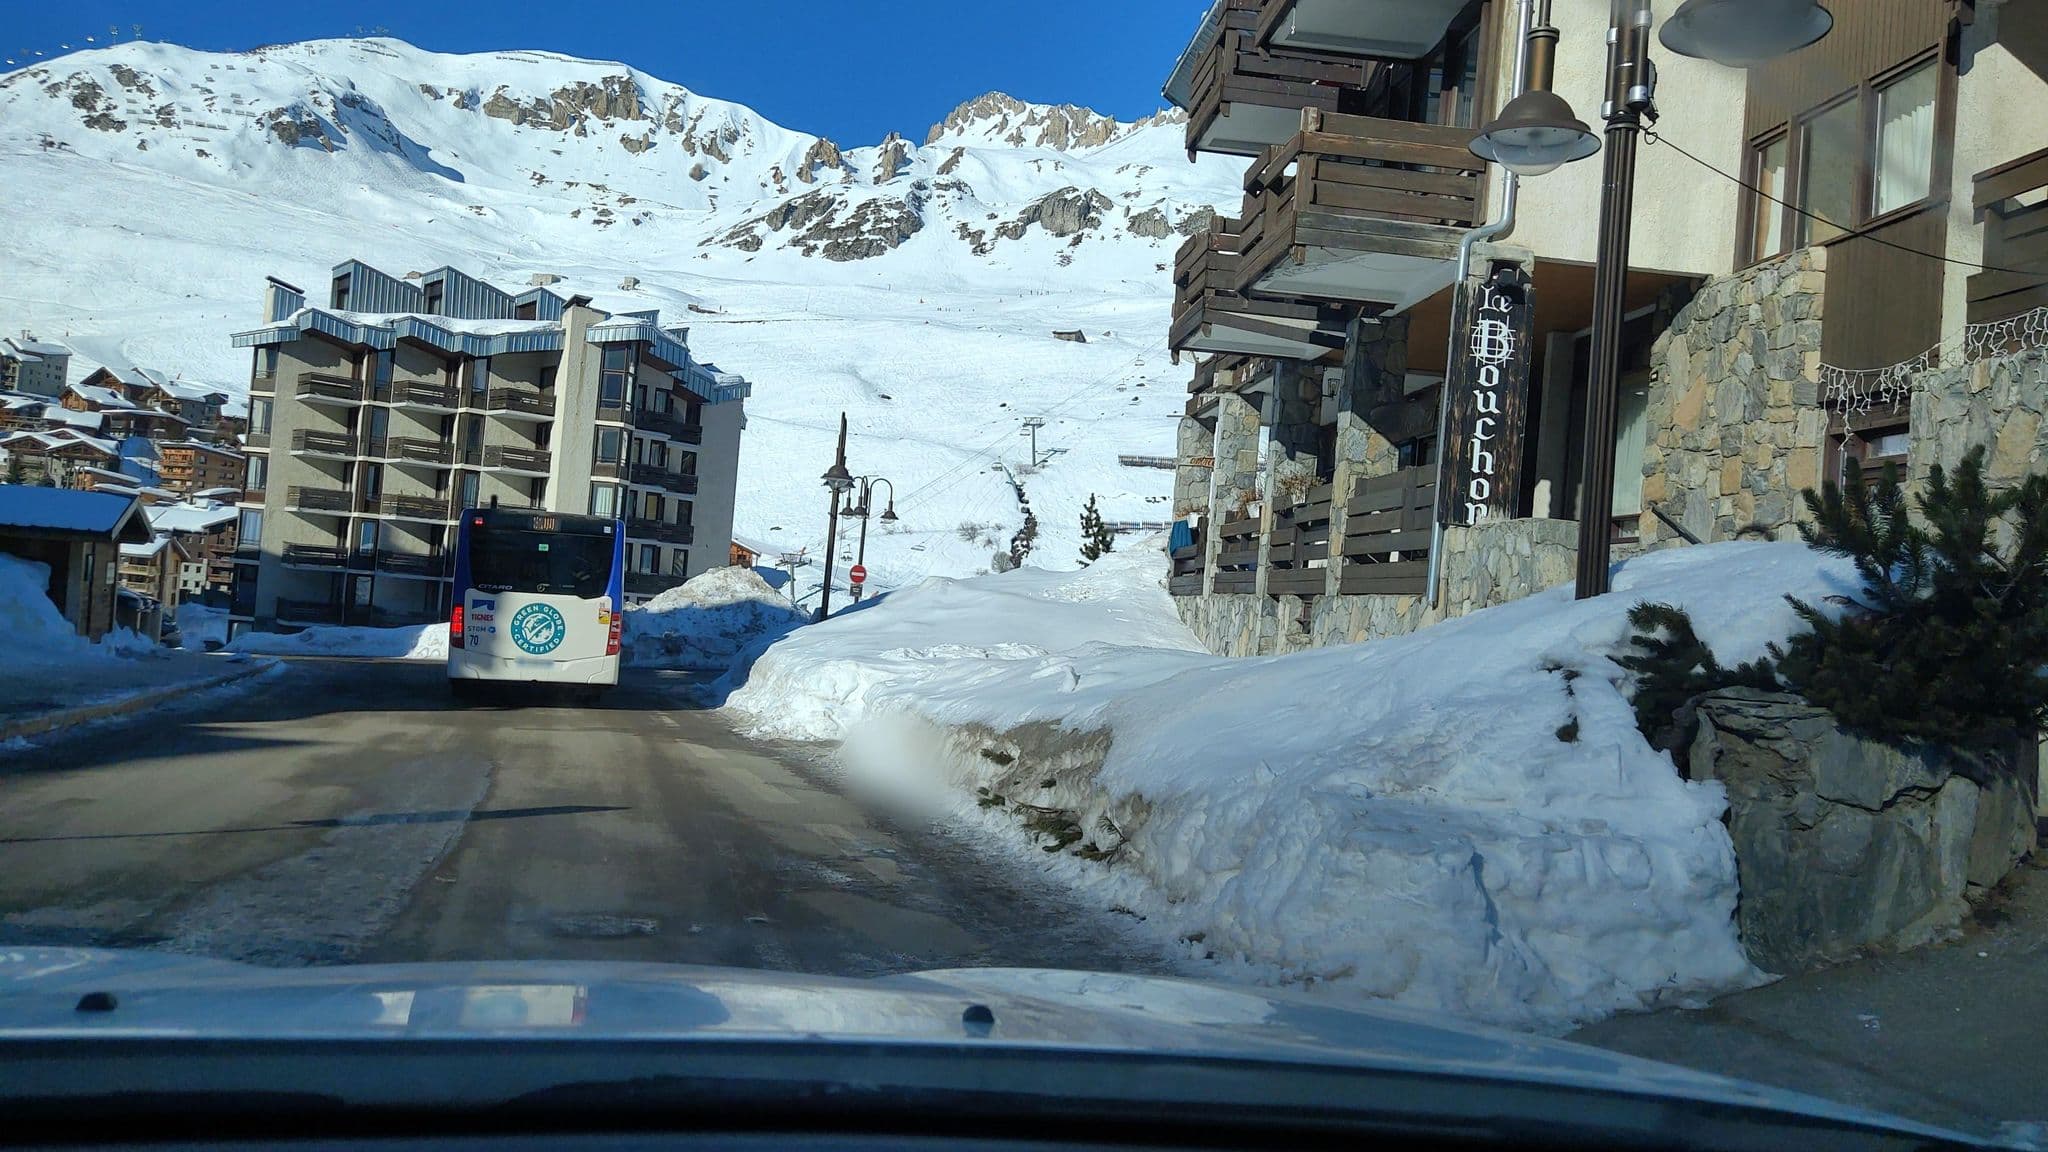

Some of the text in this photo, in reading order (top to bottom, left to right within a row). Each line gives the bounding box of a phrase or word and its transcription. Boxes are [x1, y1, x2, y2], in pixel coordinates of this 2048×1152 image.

[1465, 317, 1512, 525] Bouchon
[471, 613, 494, 621] TIGNES
[513, 604, 564, 631] GREEN GLOBE
[470, 634, 479, 646] 70
[514, 633, 560, 652] CERTIFIED
